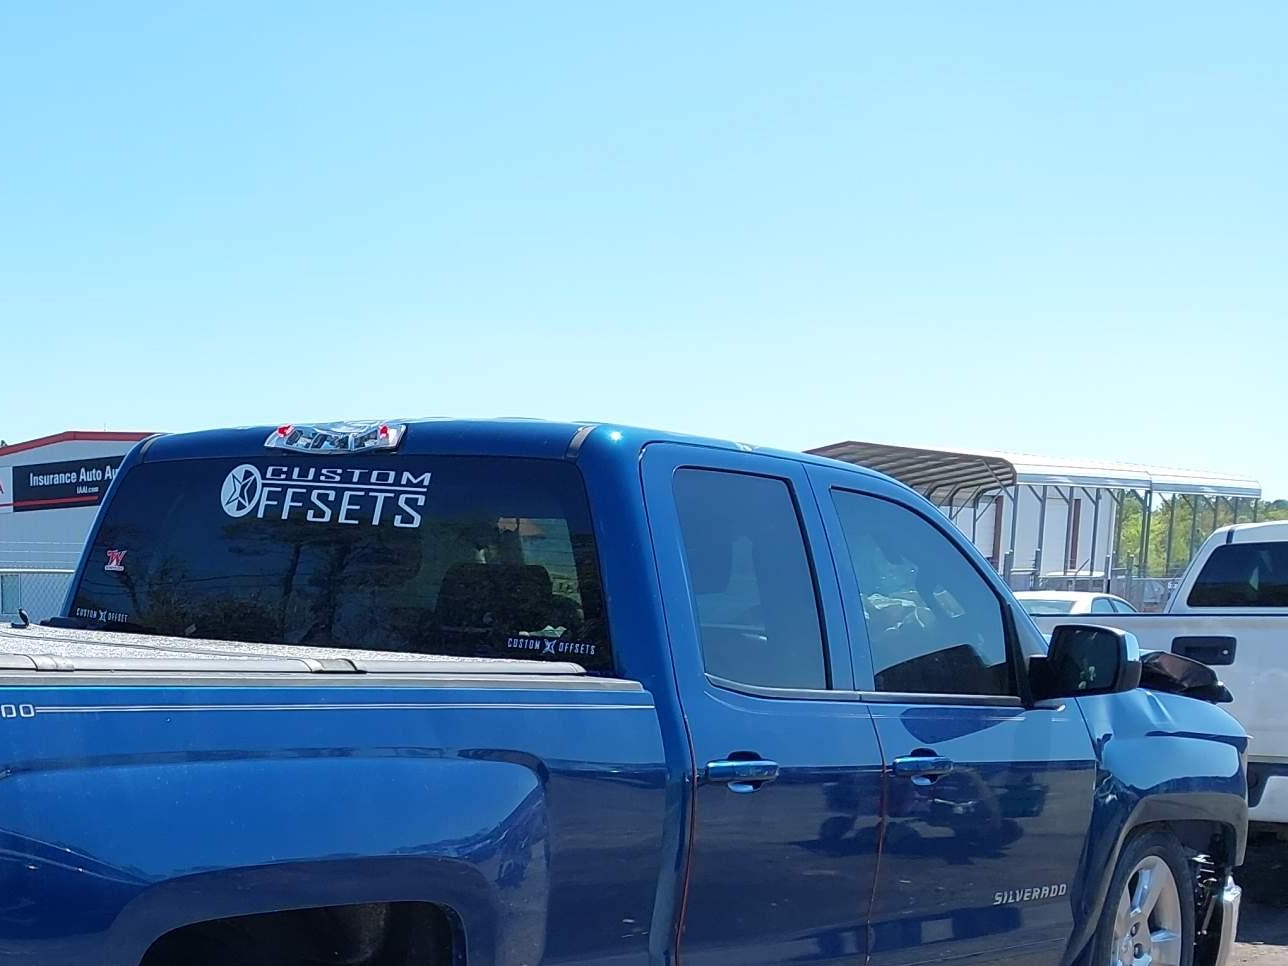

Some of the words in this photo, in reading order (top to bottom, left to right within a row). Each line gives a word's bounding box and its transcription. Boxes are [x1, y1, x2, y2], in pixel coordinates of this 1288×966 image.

[29, 471, 77, 487] Insurance
[79, 467, 102, 482] Auto
[265, 466, 432, 486] CUSTOM
[507, 638, 540, 650] CUSTOM
[558, 642, 596, 655] OFFSETS
[993, 884, 1067, 905] SILVERADO
